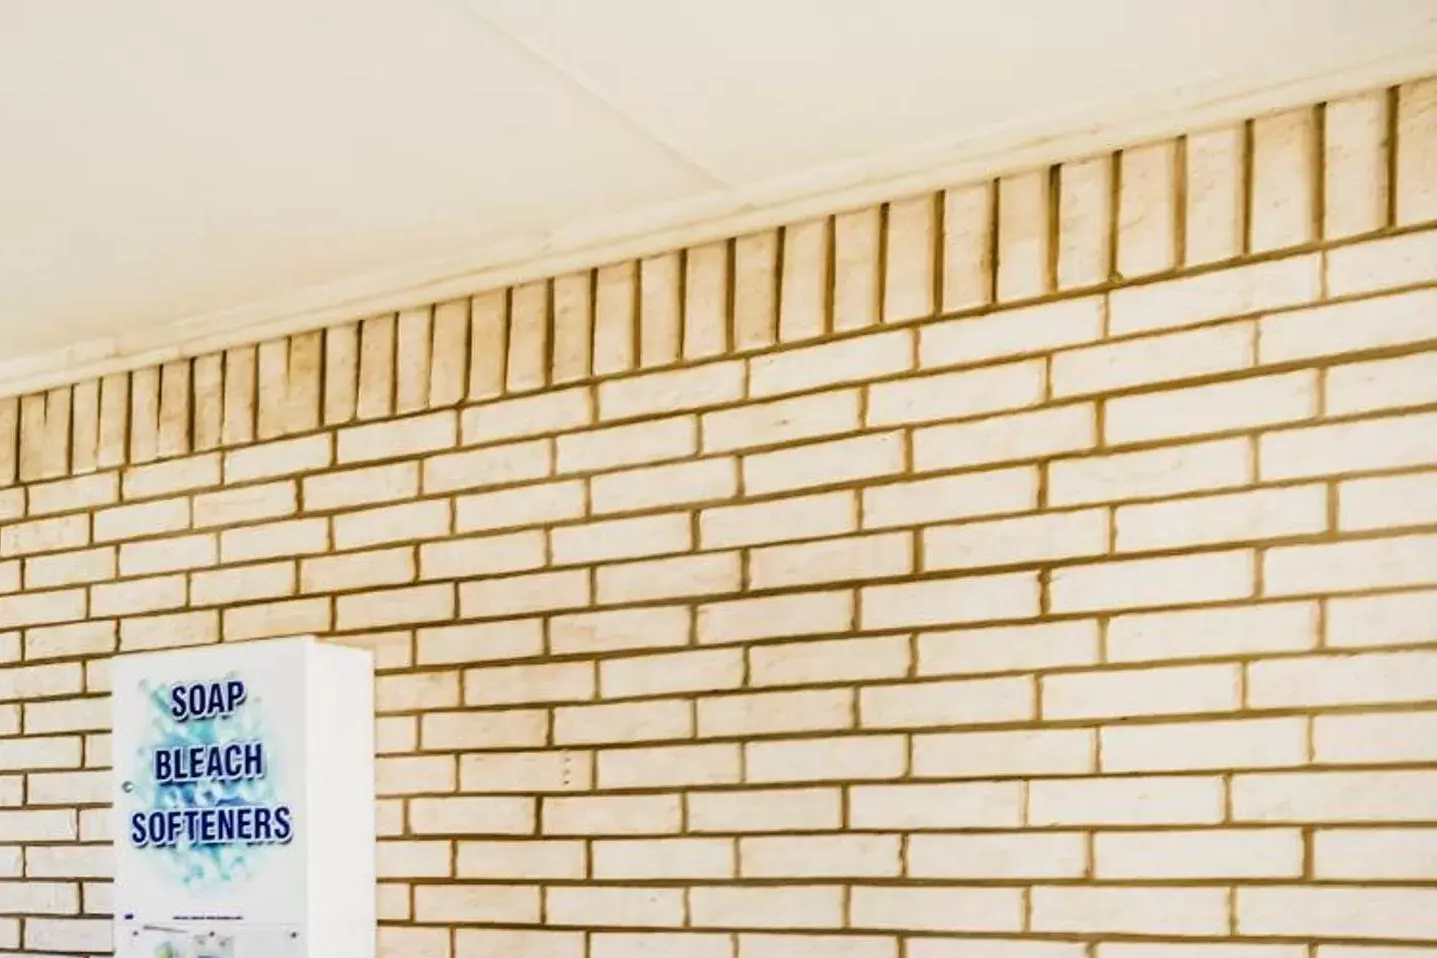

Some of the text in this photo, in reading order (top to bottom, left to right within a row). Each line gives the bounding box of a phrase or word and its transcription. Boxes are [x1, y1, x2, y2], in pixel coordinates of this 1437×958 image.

[171, 681, 244, 717] SOAP
[155, 743, 262, 780] BLEACH
[131, 807, 291, 843] SOFTENERS
